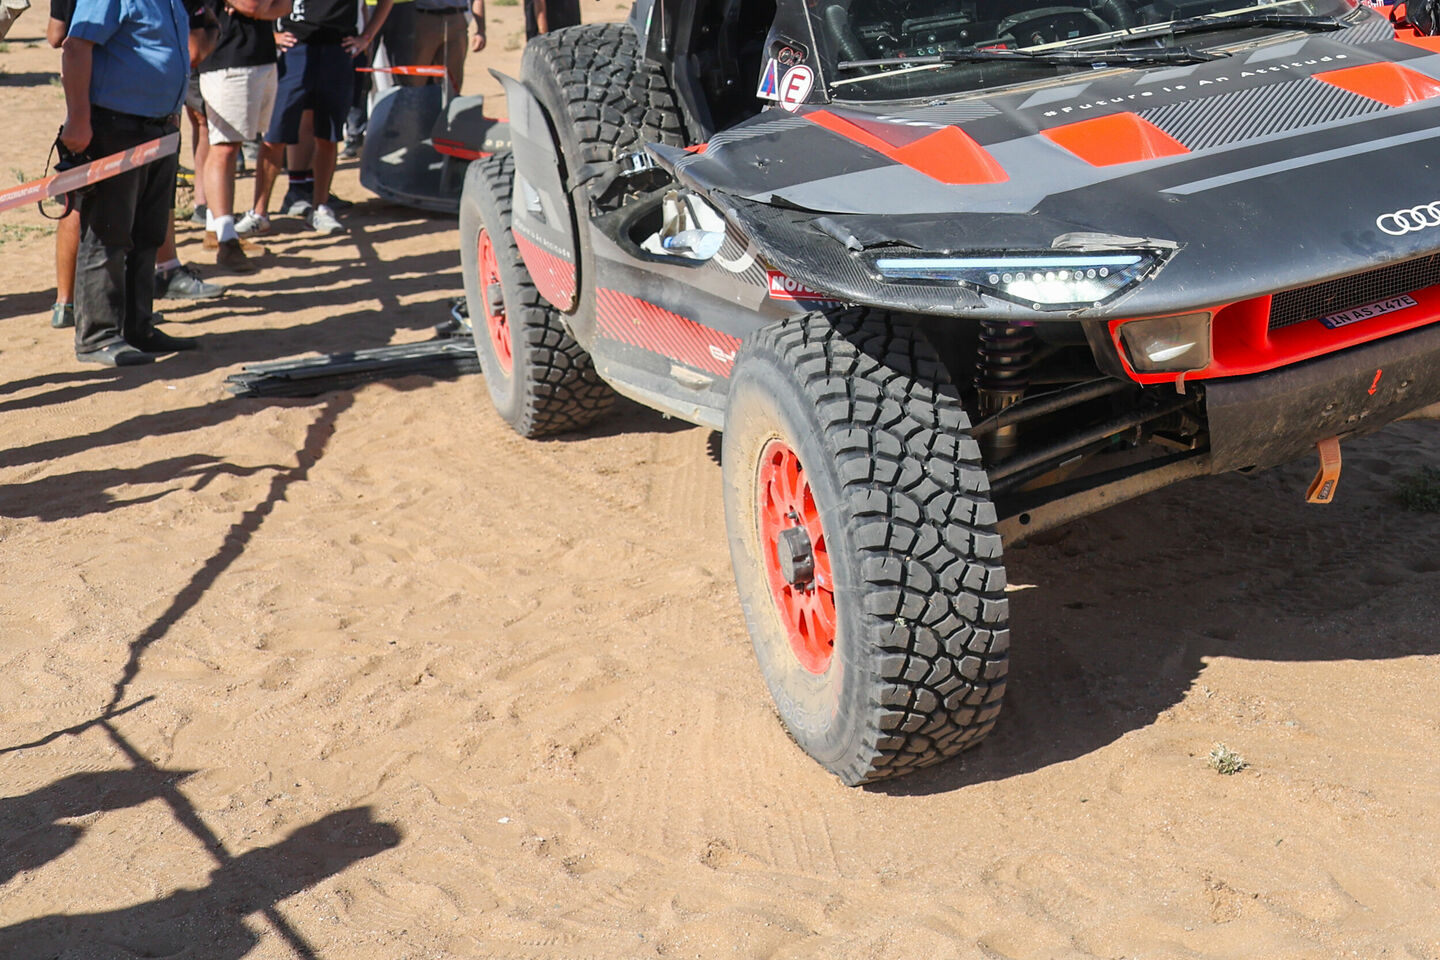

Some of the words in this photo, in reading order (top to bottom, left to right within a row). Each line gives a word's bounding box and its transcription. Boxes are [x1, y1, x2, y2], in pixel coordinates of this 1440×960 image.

[785, 73, 806, 103] E
[1043, 91, 1153, 117] #Future
[1199, 76, 1229, 86] An
[1240, 54, 1348, 79] Attitude
[1330, 313, 1351, 324] IN
[1352, 308, 1373, 319] AS
[1374, 296, 1415, 313] 147E
